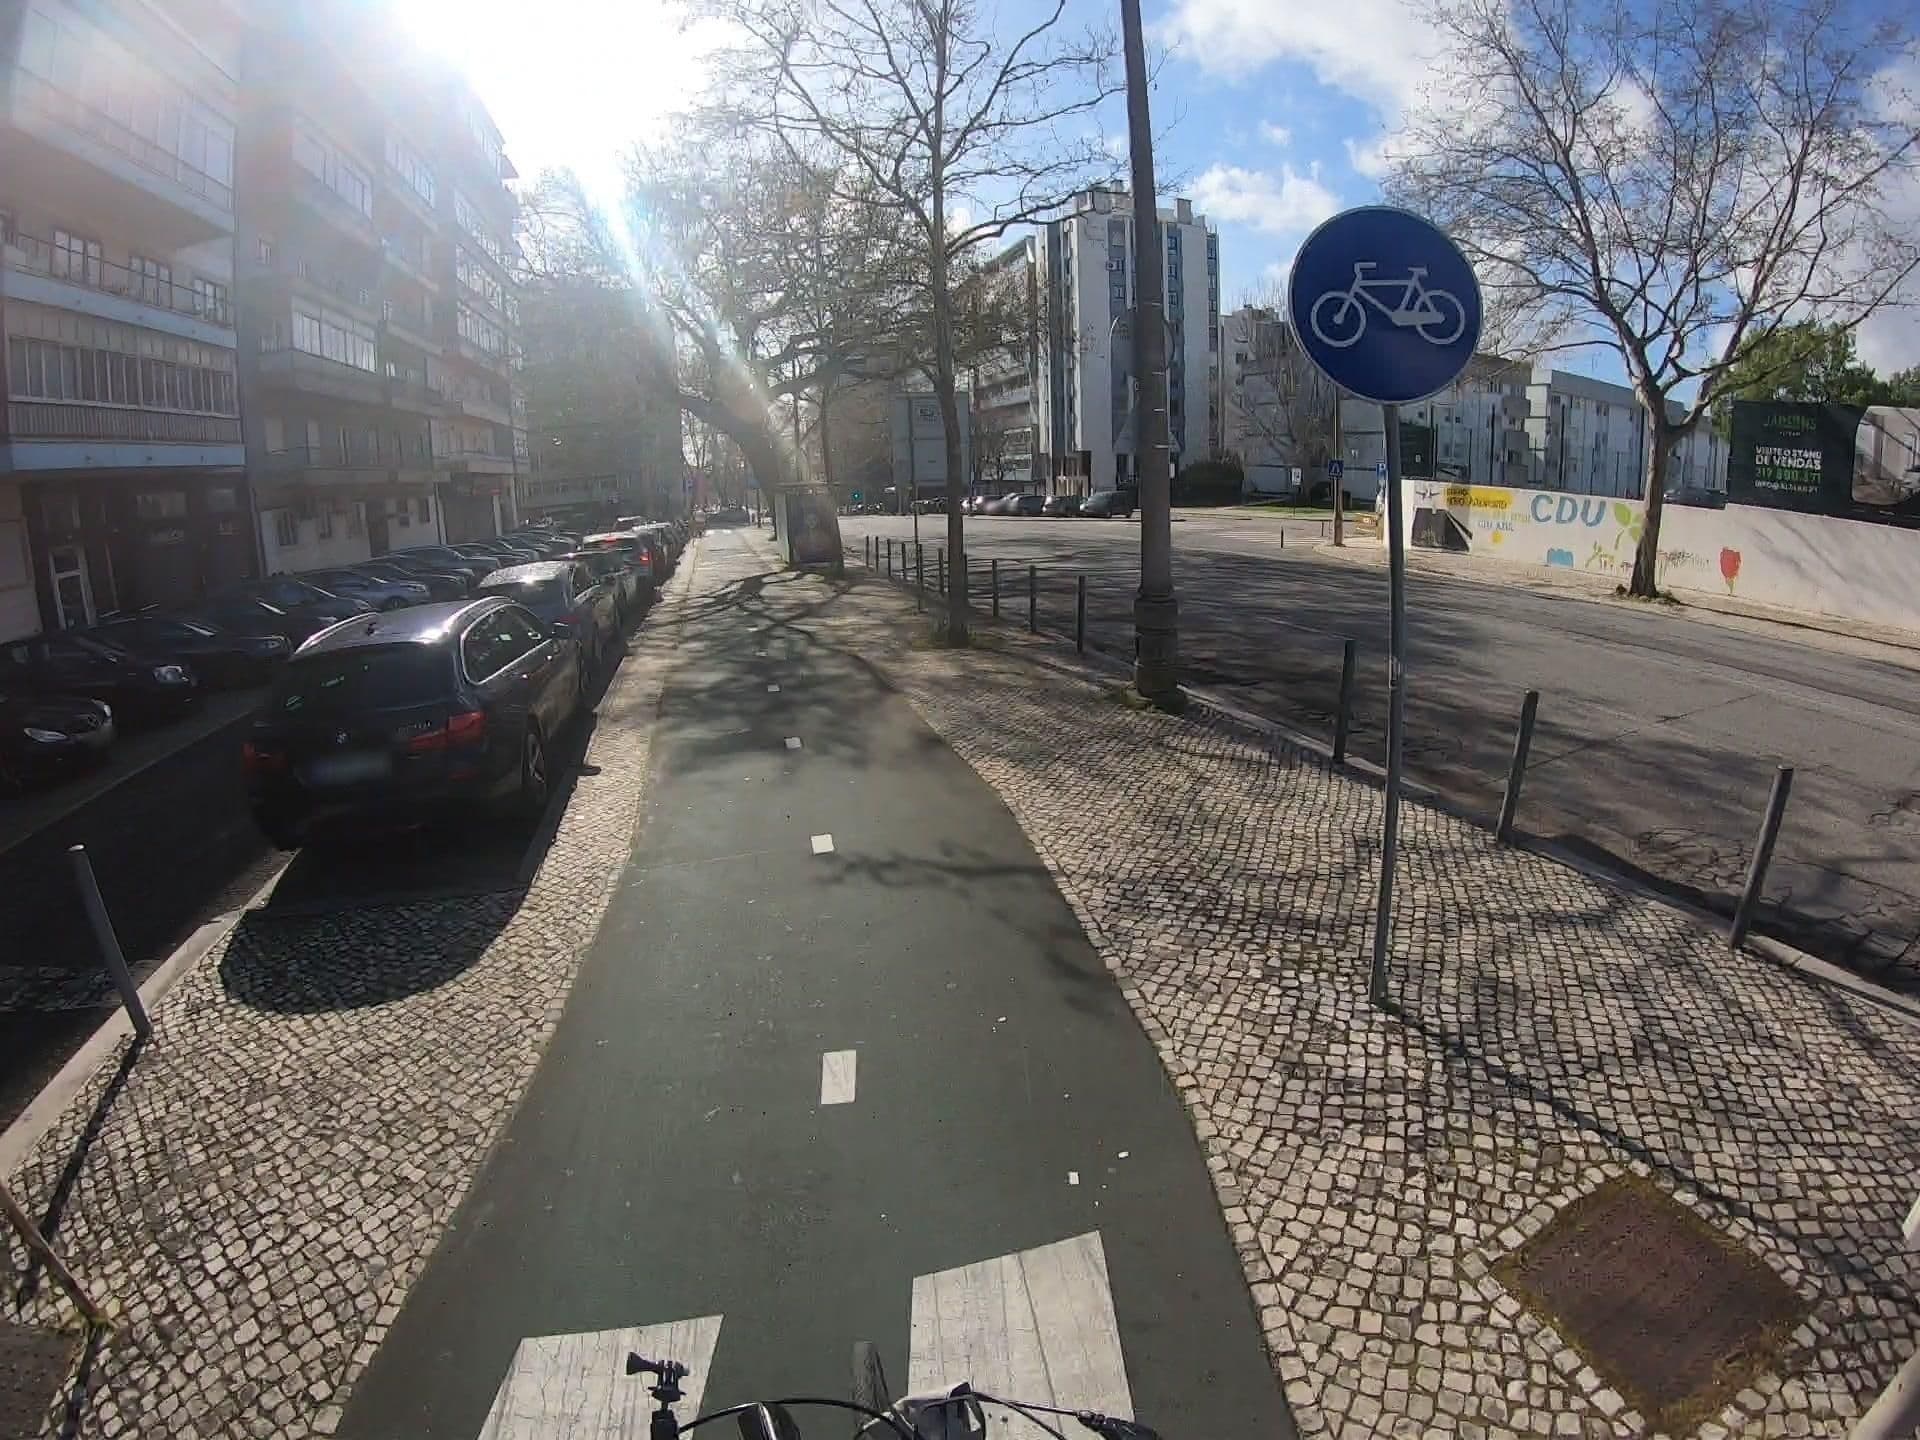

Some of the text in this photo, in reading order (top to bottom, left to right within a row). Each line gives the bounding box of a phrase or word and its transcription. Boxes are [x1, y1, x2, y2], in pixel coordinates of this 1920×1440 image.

[1755, 455, 1822, 471] DE VENDAS
[1530, 494, 1606, 527] CDU
